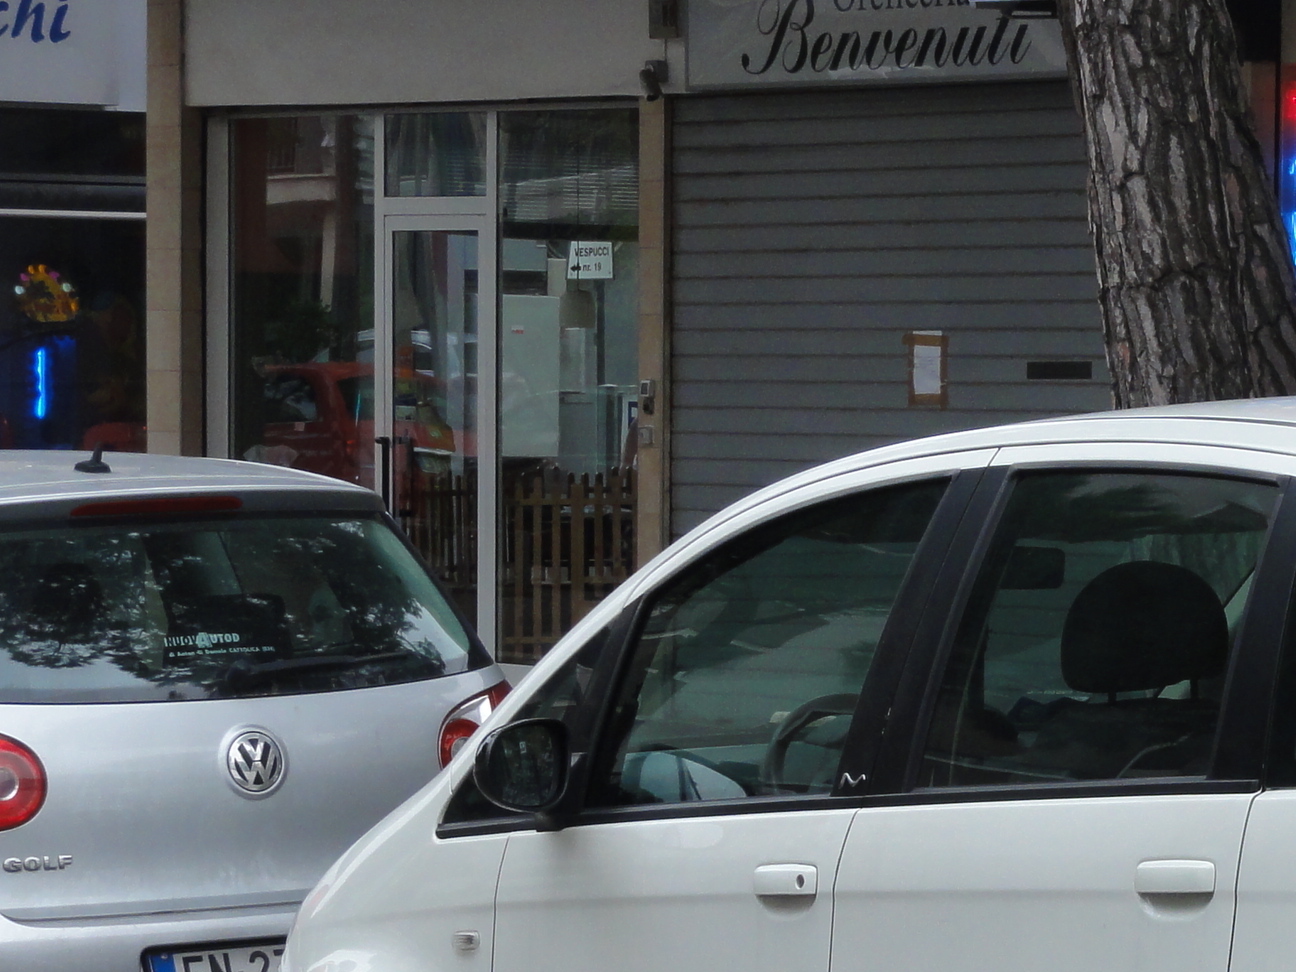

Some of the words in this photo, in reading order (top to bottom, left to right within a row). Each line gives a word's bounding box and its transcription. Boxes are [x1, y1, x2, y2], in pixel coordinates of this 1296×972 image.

[741, 0, 1032, 75] Benvenuti
[574, 246, 610, 257] VESPUCCI
[2, 854, 73, 873] GOLF
